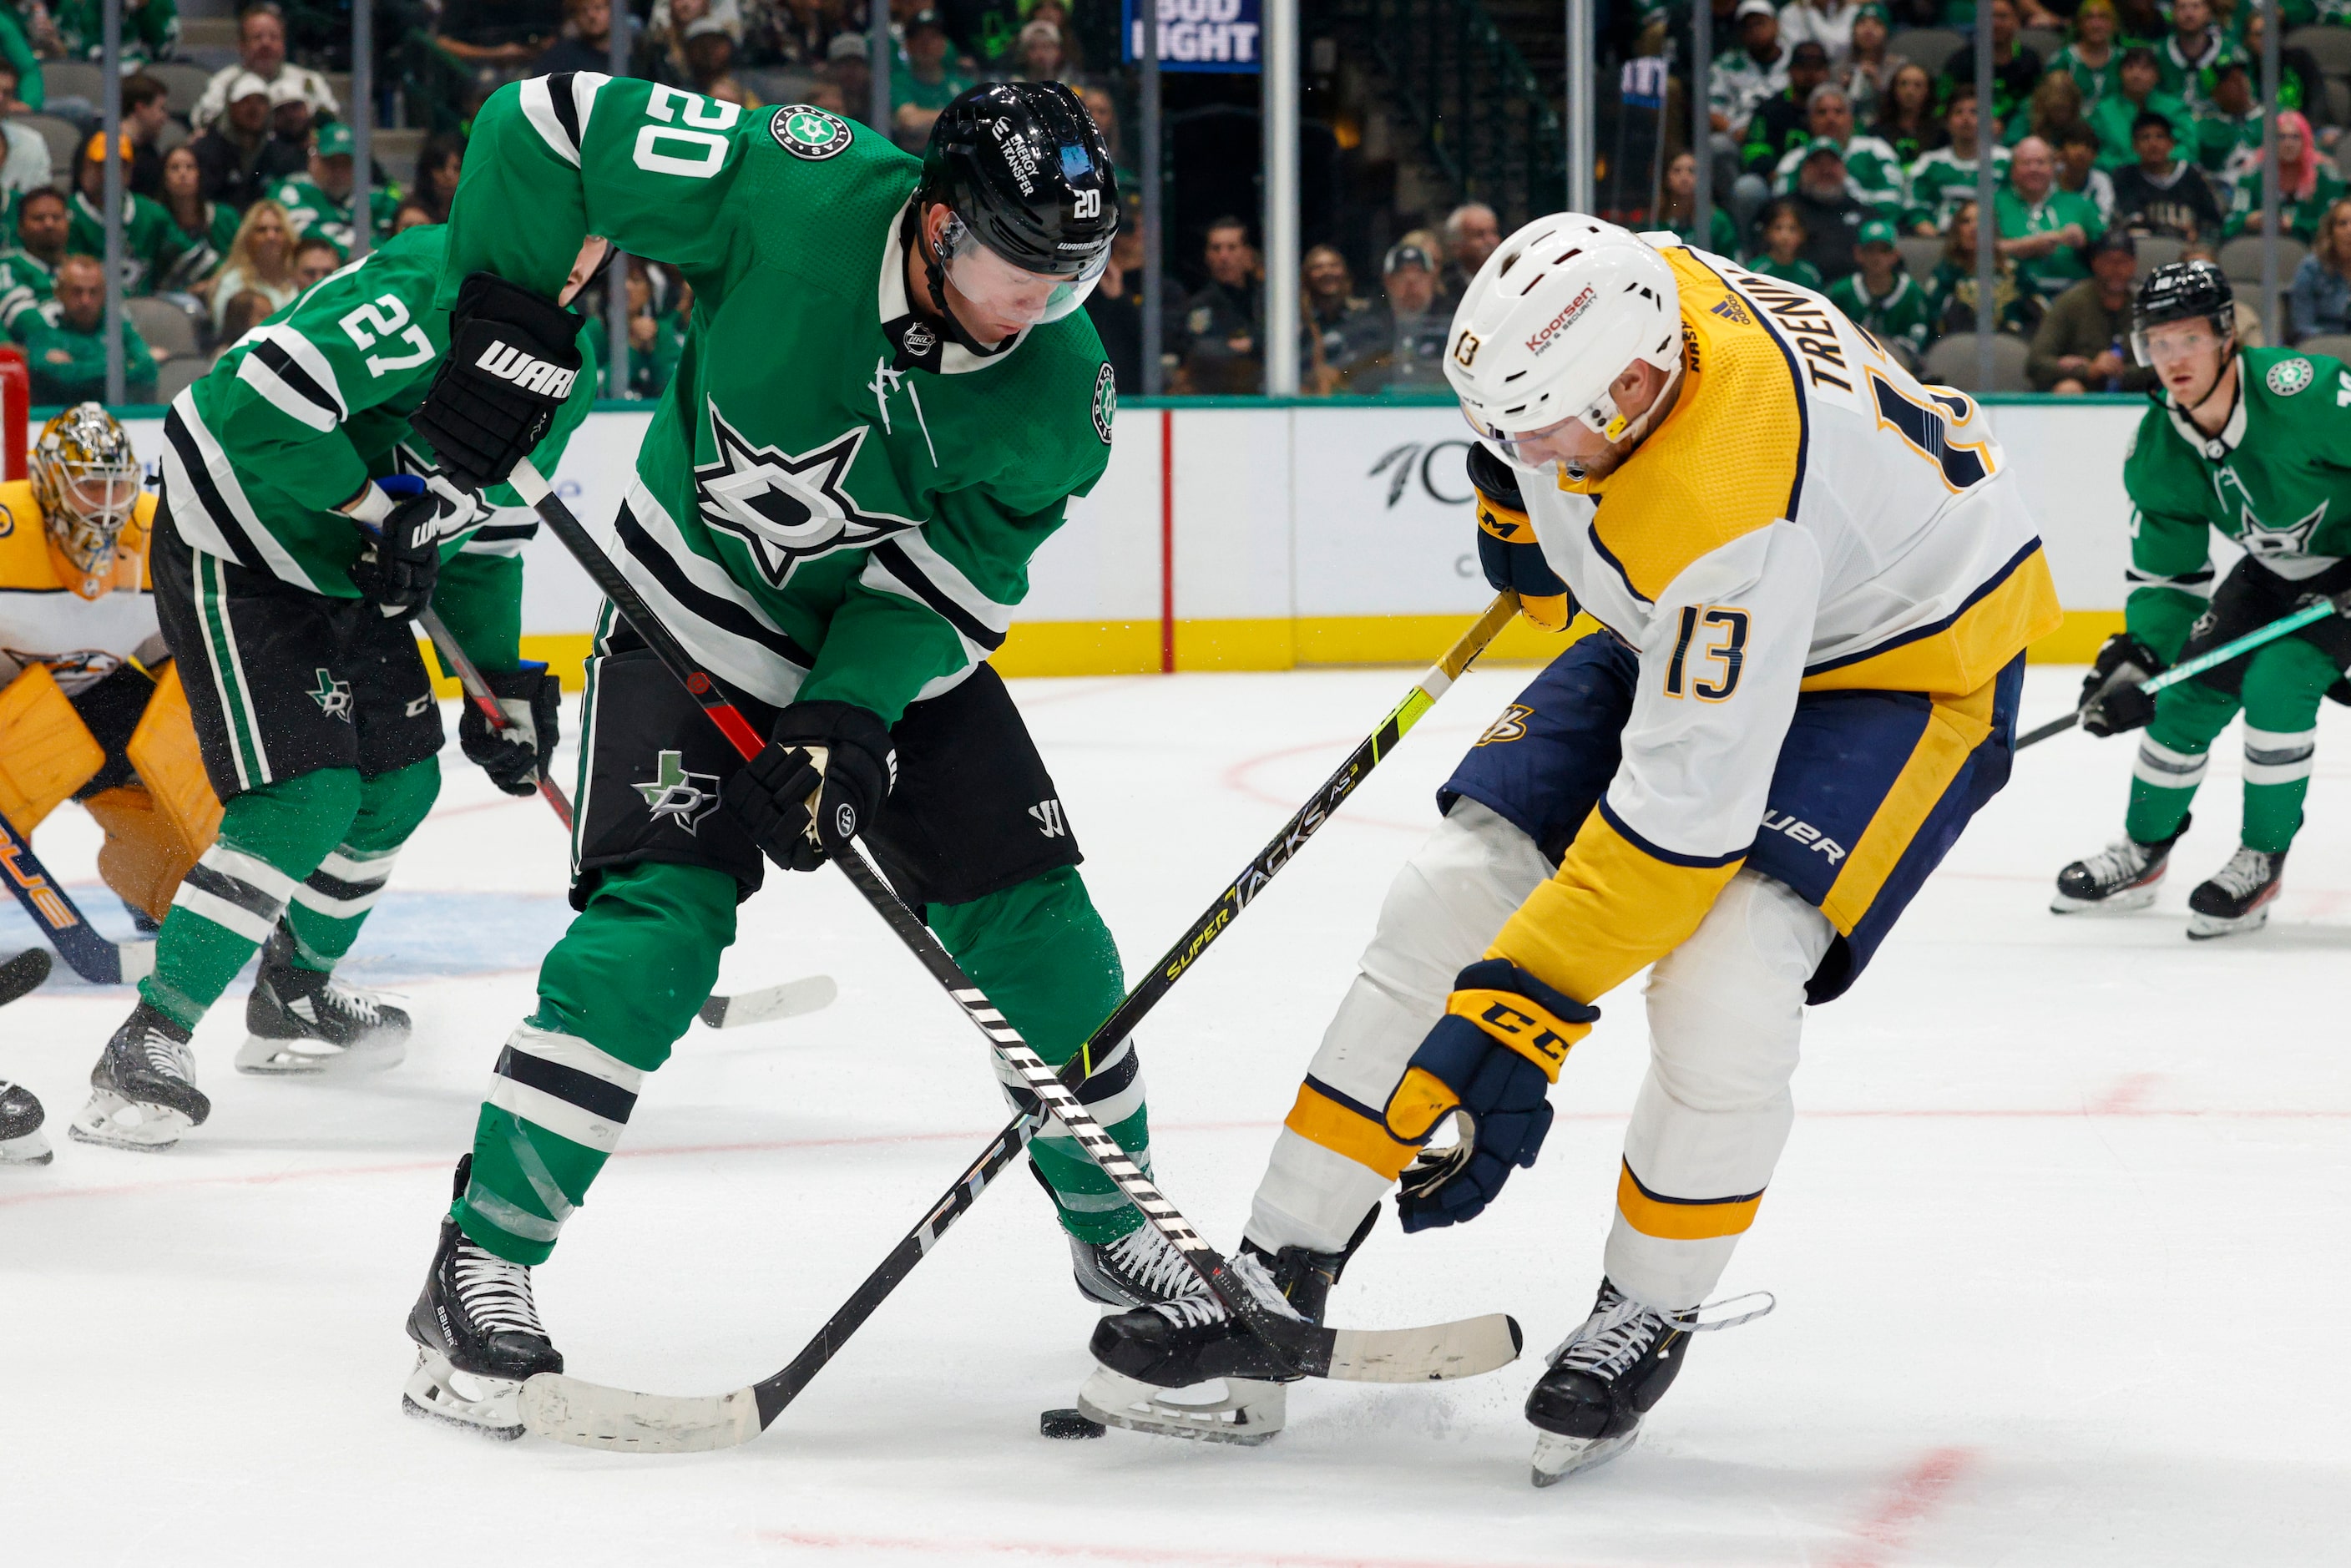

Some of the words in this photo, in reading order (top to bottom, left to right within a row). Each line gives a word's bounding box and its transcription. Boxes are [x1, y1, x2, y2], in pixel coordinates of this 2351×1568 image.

[632, 82, 741, 179] 20
[1009, 134, 1040, 177] ENERGY
[1000, 139, 1034, 198] TRANSFER
[1073, 189, 1101, 219] 20
[1057, 239, 1104, 250] WARRIOR
[338, 293, 436, 378] 27
[1525, 285, 1595, 352] Koorsen
[1534, 340, 1552, 358] FIRE
[1562, 292, 1599, 331] SECURITY
[1725, 293, 1752, 326] adidas
[474, 339, 580, 399] WAR
[1454, 329, 1481, 367] 13
[1663, 604, 1752, 704] 13
[1166, 908, 1230, 981] SUPER
[1481, 1001, 1570, 1067] CC
[950, 988, 1211, 1253] WARRIOR
